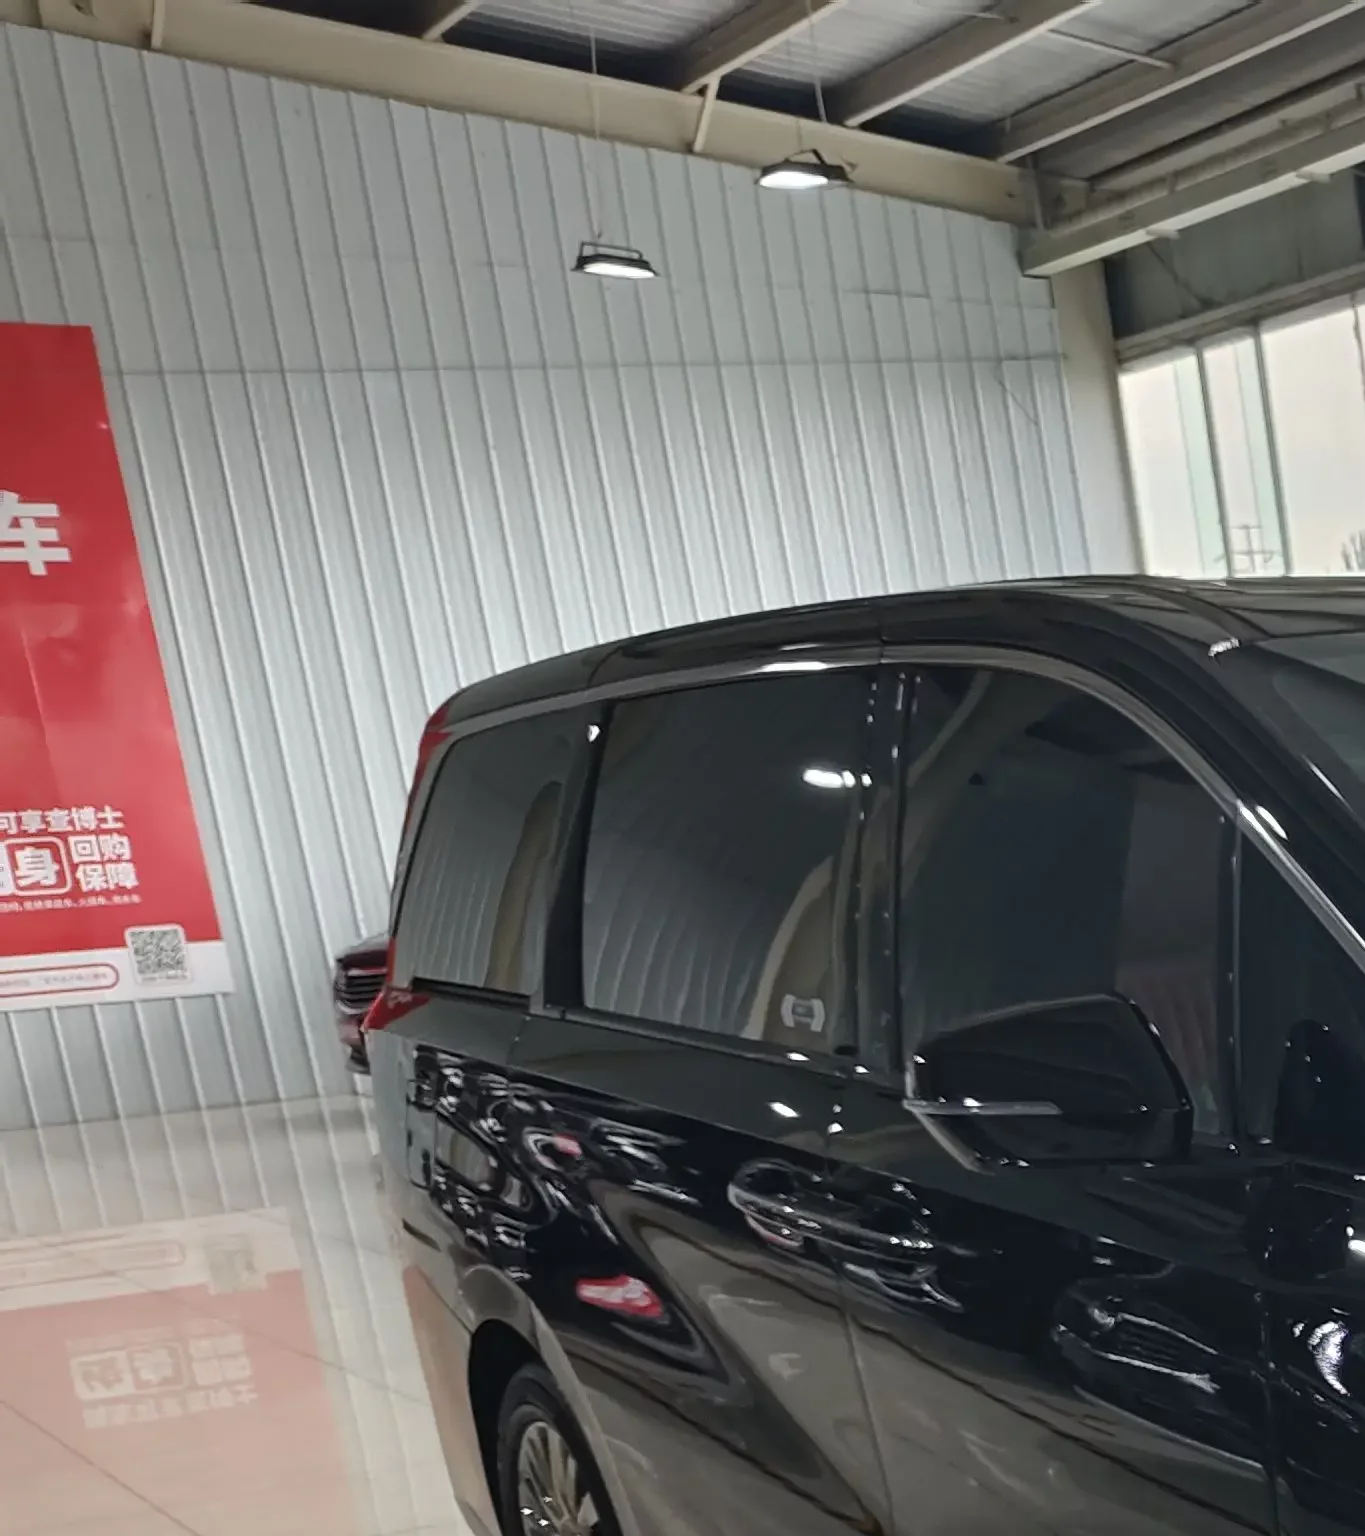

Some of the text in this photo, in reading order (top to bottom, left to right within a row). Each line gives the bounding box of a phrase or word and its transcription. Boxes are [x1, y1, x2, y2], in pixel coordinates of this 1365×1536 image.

[0, 489, 73, 577] 车
[14, 832, 133, 888] 身 回购
[75, 862, 139, 893] 保障
